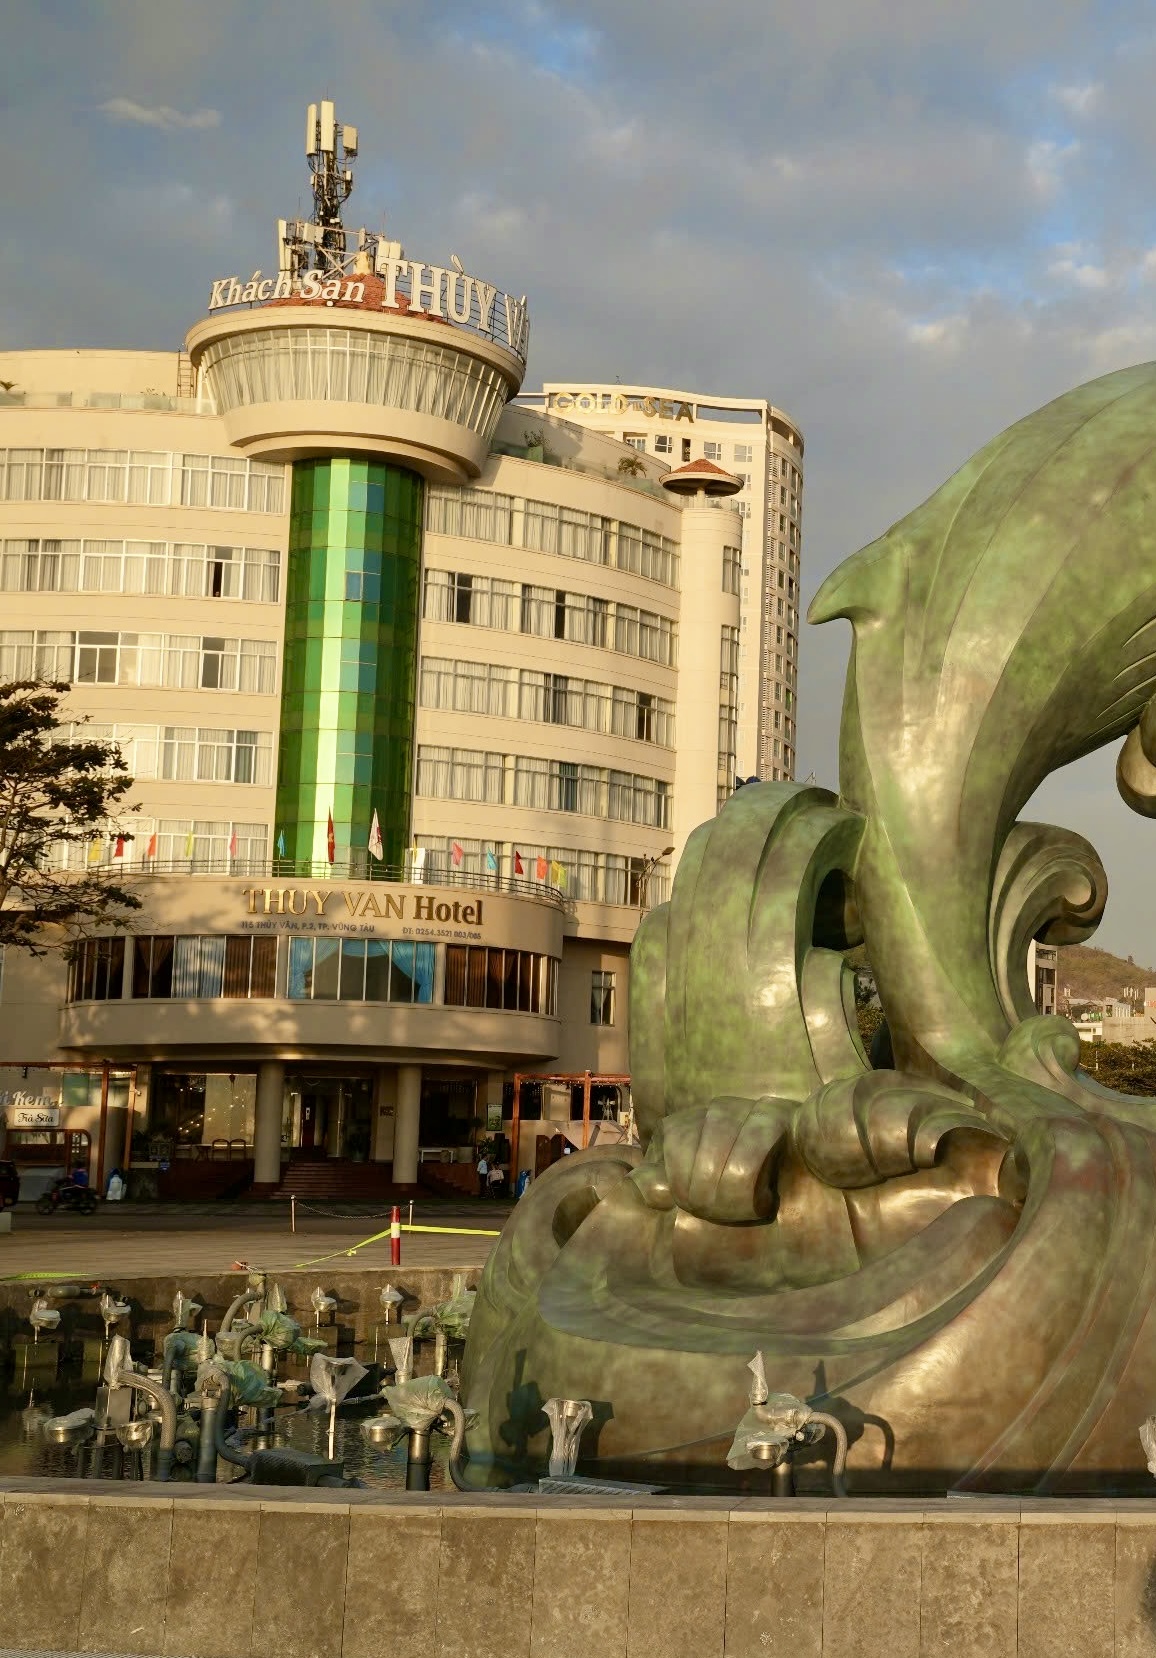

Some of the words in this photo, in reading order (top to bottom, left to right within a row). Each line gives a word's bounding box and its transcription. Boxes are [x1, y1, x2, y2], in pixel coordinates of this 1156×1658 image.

[208, 270, 292, 310] Khách
[299, 269, 365, 307] Sạn
[376, 254, 497, 334] THÙY
[554, 391, 629, 415] GOLD
[643, 396, 695, 423] SEA
[242, 888, 333, 916] THUY
[342, 891, 407, 920] VAN
[413, 895, 484, 926] Hotel
